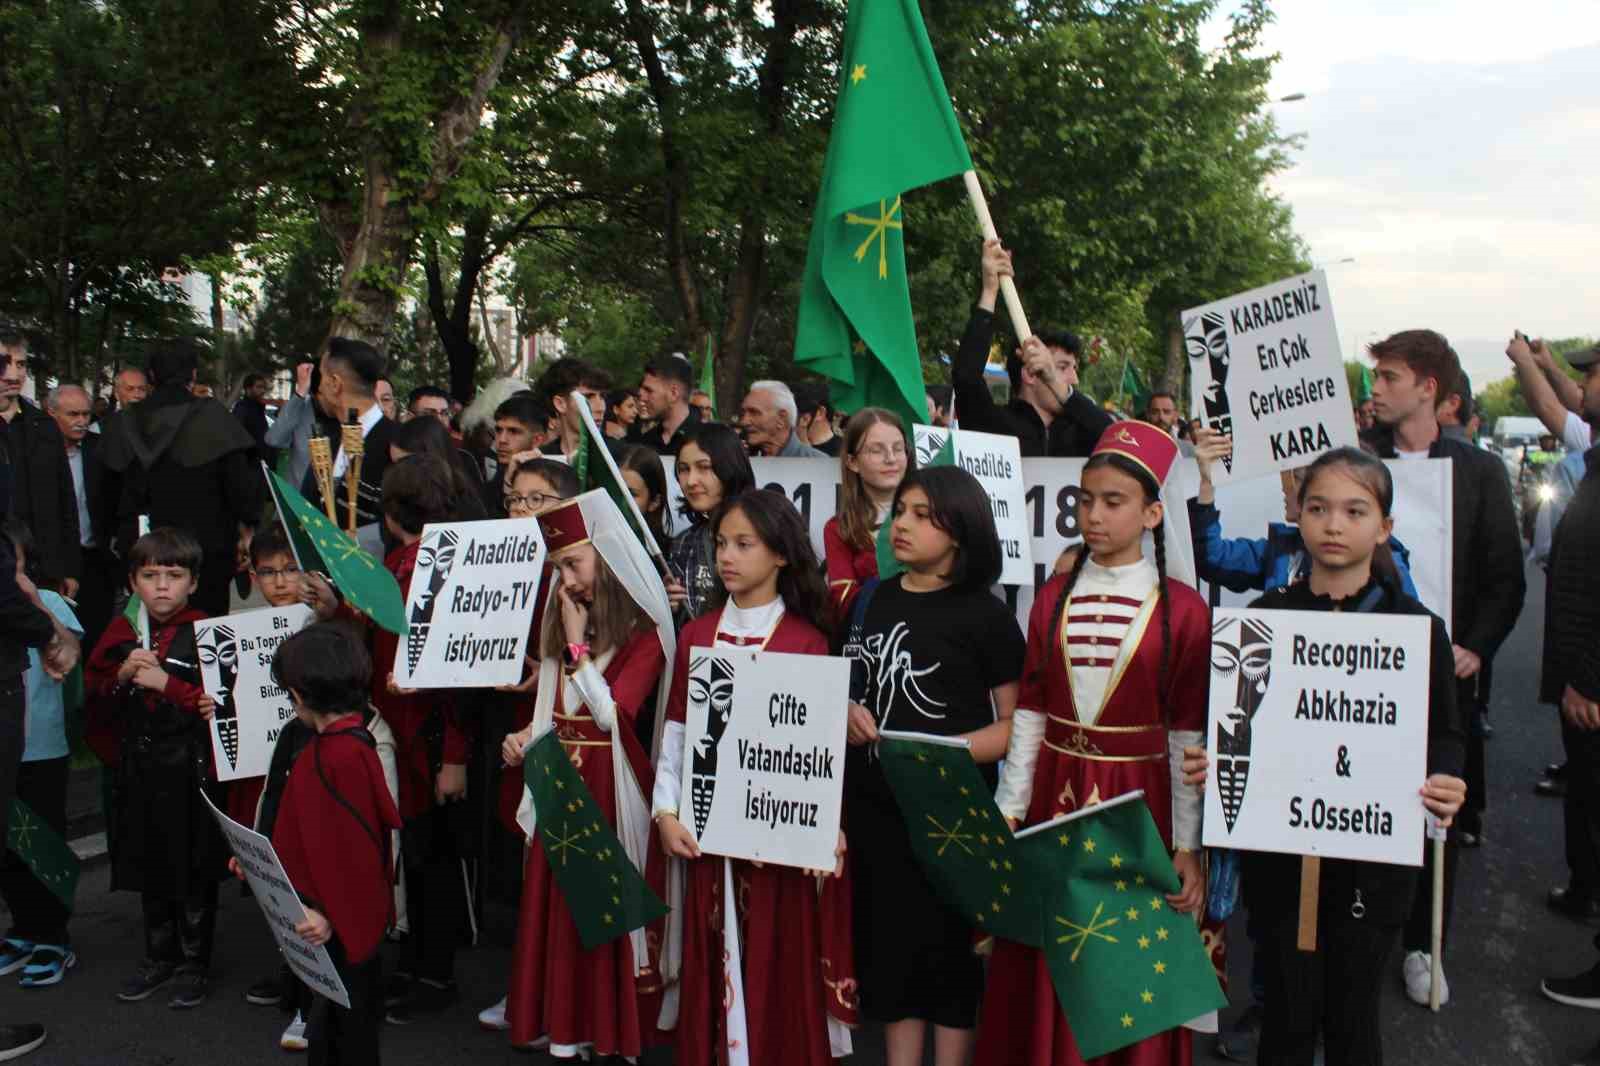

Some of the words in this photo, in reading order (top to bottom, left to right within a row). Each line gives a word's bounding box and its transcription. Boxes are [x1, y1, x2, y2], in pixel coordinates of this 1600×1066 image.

[1230, 278, 1321, 336] KARADENİZ
[1256, 343, 1279, 371] En
[1279, 334, 1311, 369] Çok
[1248, 375, 1336, 421] Çerkeslere
[1269, 422, 1333, 462] KARA
[958, 449, 1012, 479] Anadilde
[463, 535, 538, 566] Anadilde
[450, 581, 534, 619] Radyo-TV
[272, 615, 289, 630] Biz
[240, 637, 255, 651] Bu
[444, 632, 519, 668] istiyoruz
[1292, 634, 1406, 676] Recognize
[768, 692, 807, 727] Çifte
[1294, 688, 1397, 726] Abkhazia
[738, 738, 834, 781] Vatandaşlık
[1335, 744, 1352, 778] &
[745, 780, 819, 830] İstiyoruz
[1288, 796, 1393, 837] S.Ossetia
